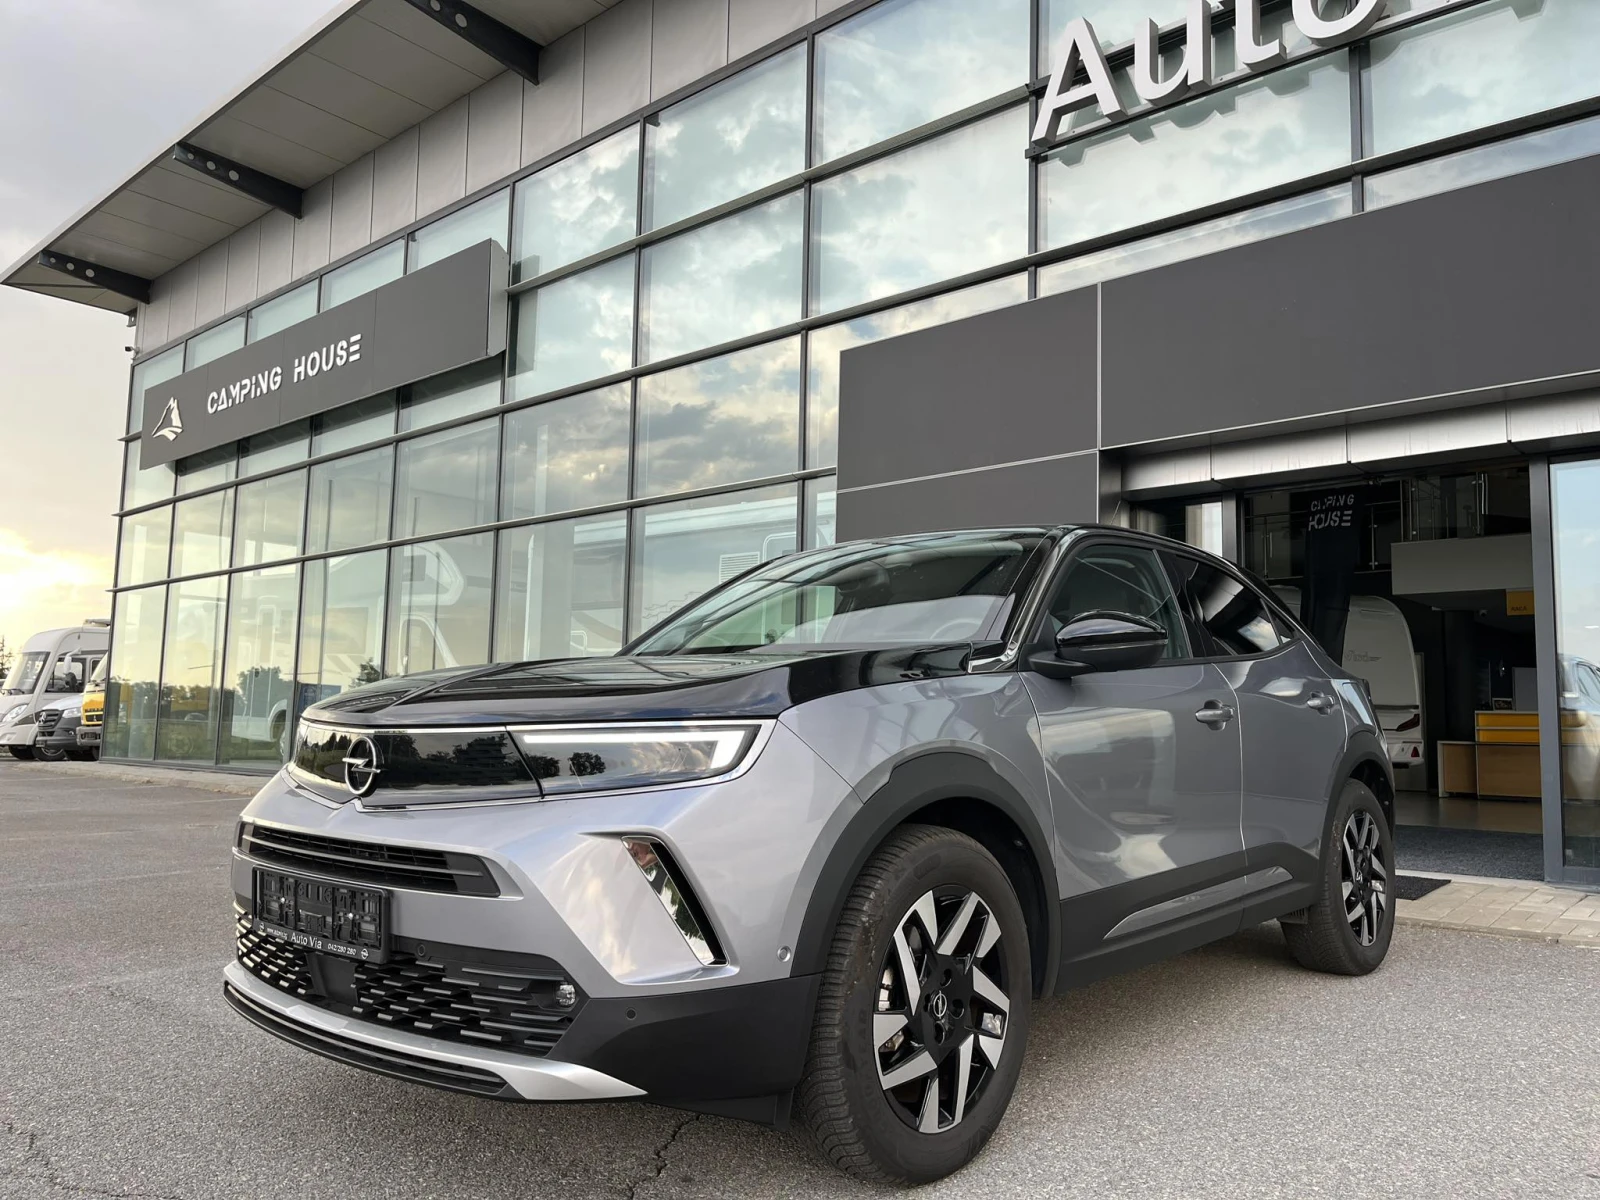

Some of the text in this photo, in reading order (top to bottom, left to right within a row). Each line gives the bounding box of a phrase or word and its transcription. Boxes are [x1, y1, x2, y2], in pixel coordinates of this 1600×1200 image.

[207, 333, 362, 415] CAMPING HOUSE
[291, 932, 308, 945] Auto
[310, 936, 322, 949] Via
